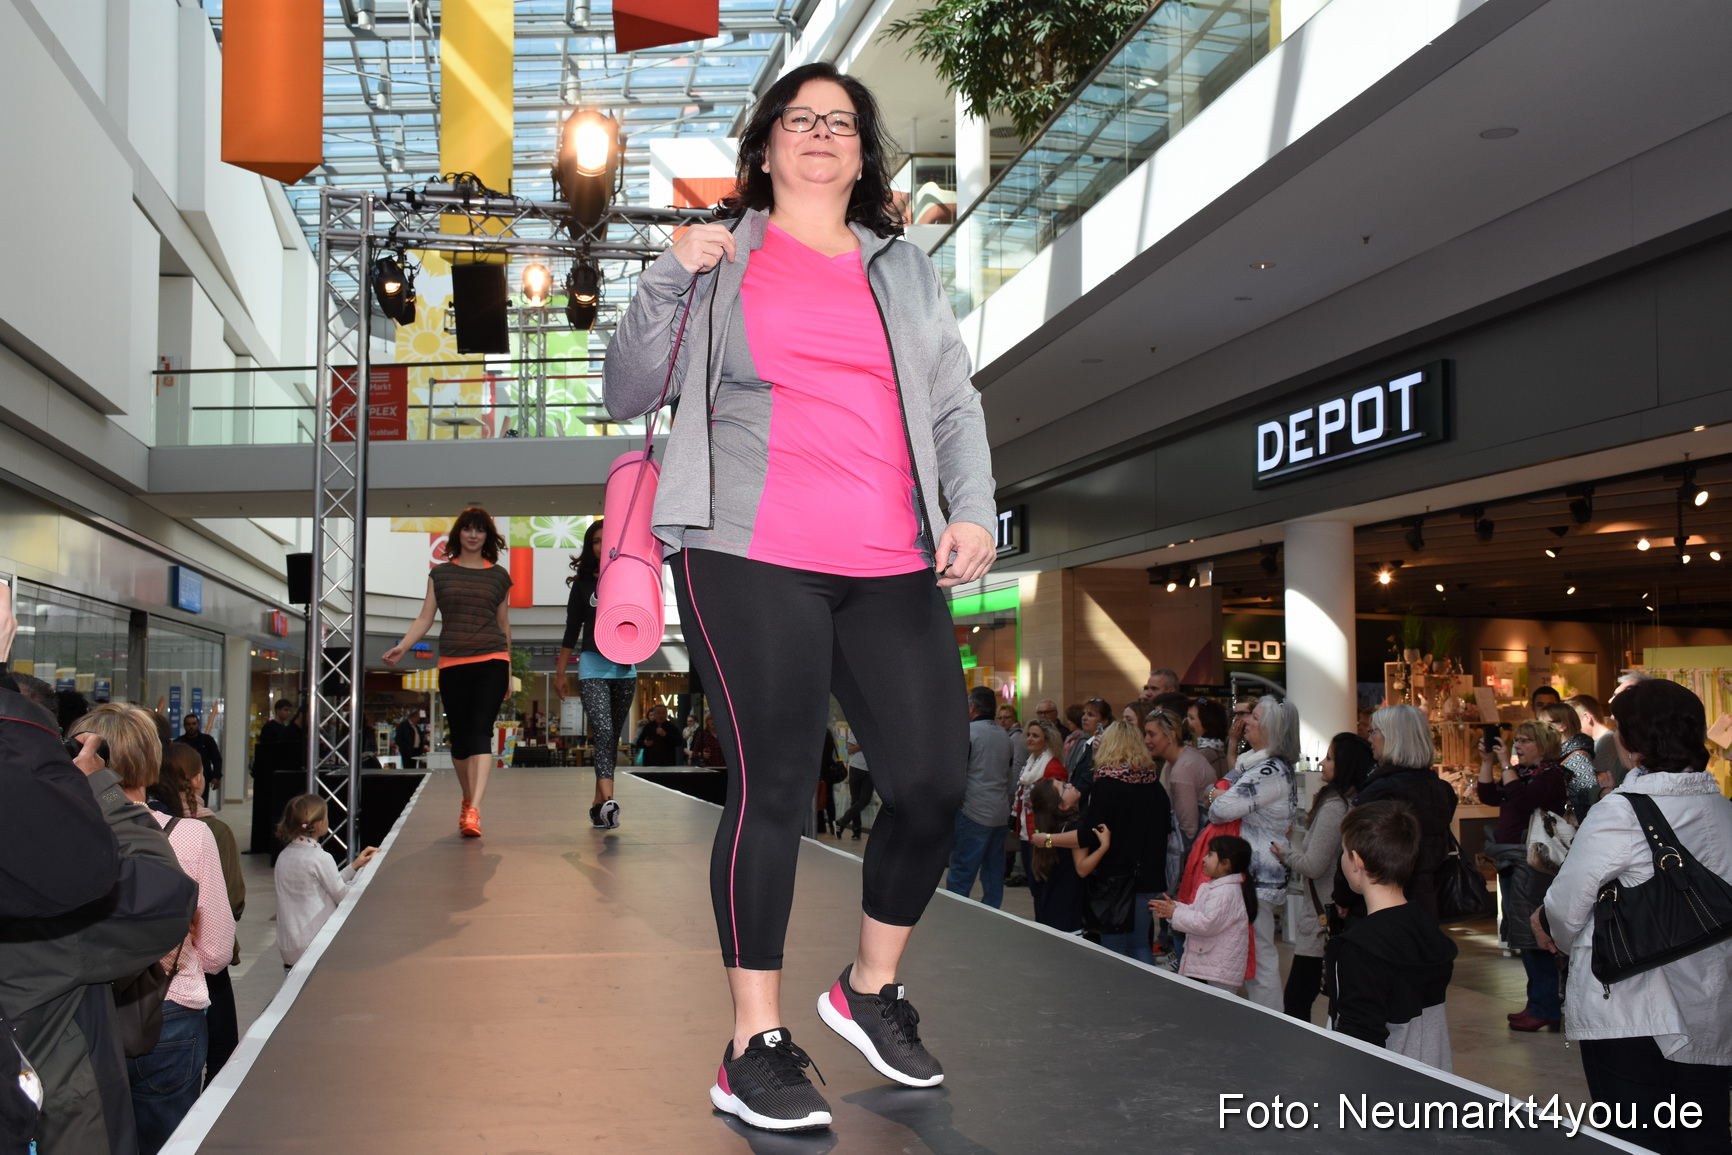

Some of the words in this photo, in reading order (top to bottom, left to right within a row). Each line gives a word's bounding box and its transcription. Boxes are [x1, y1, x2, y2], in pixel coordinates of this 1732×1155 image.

[340, 406, 398, 418] CIPLEX
[1258, 371, 1423, 473] DEPOT
[1222, 639, 1287, 660] EPO
